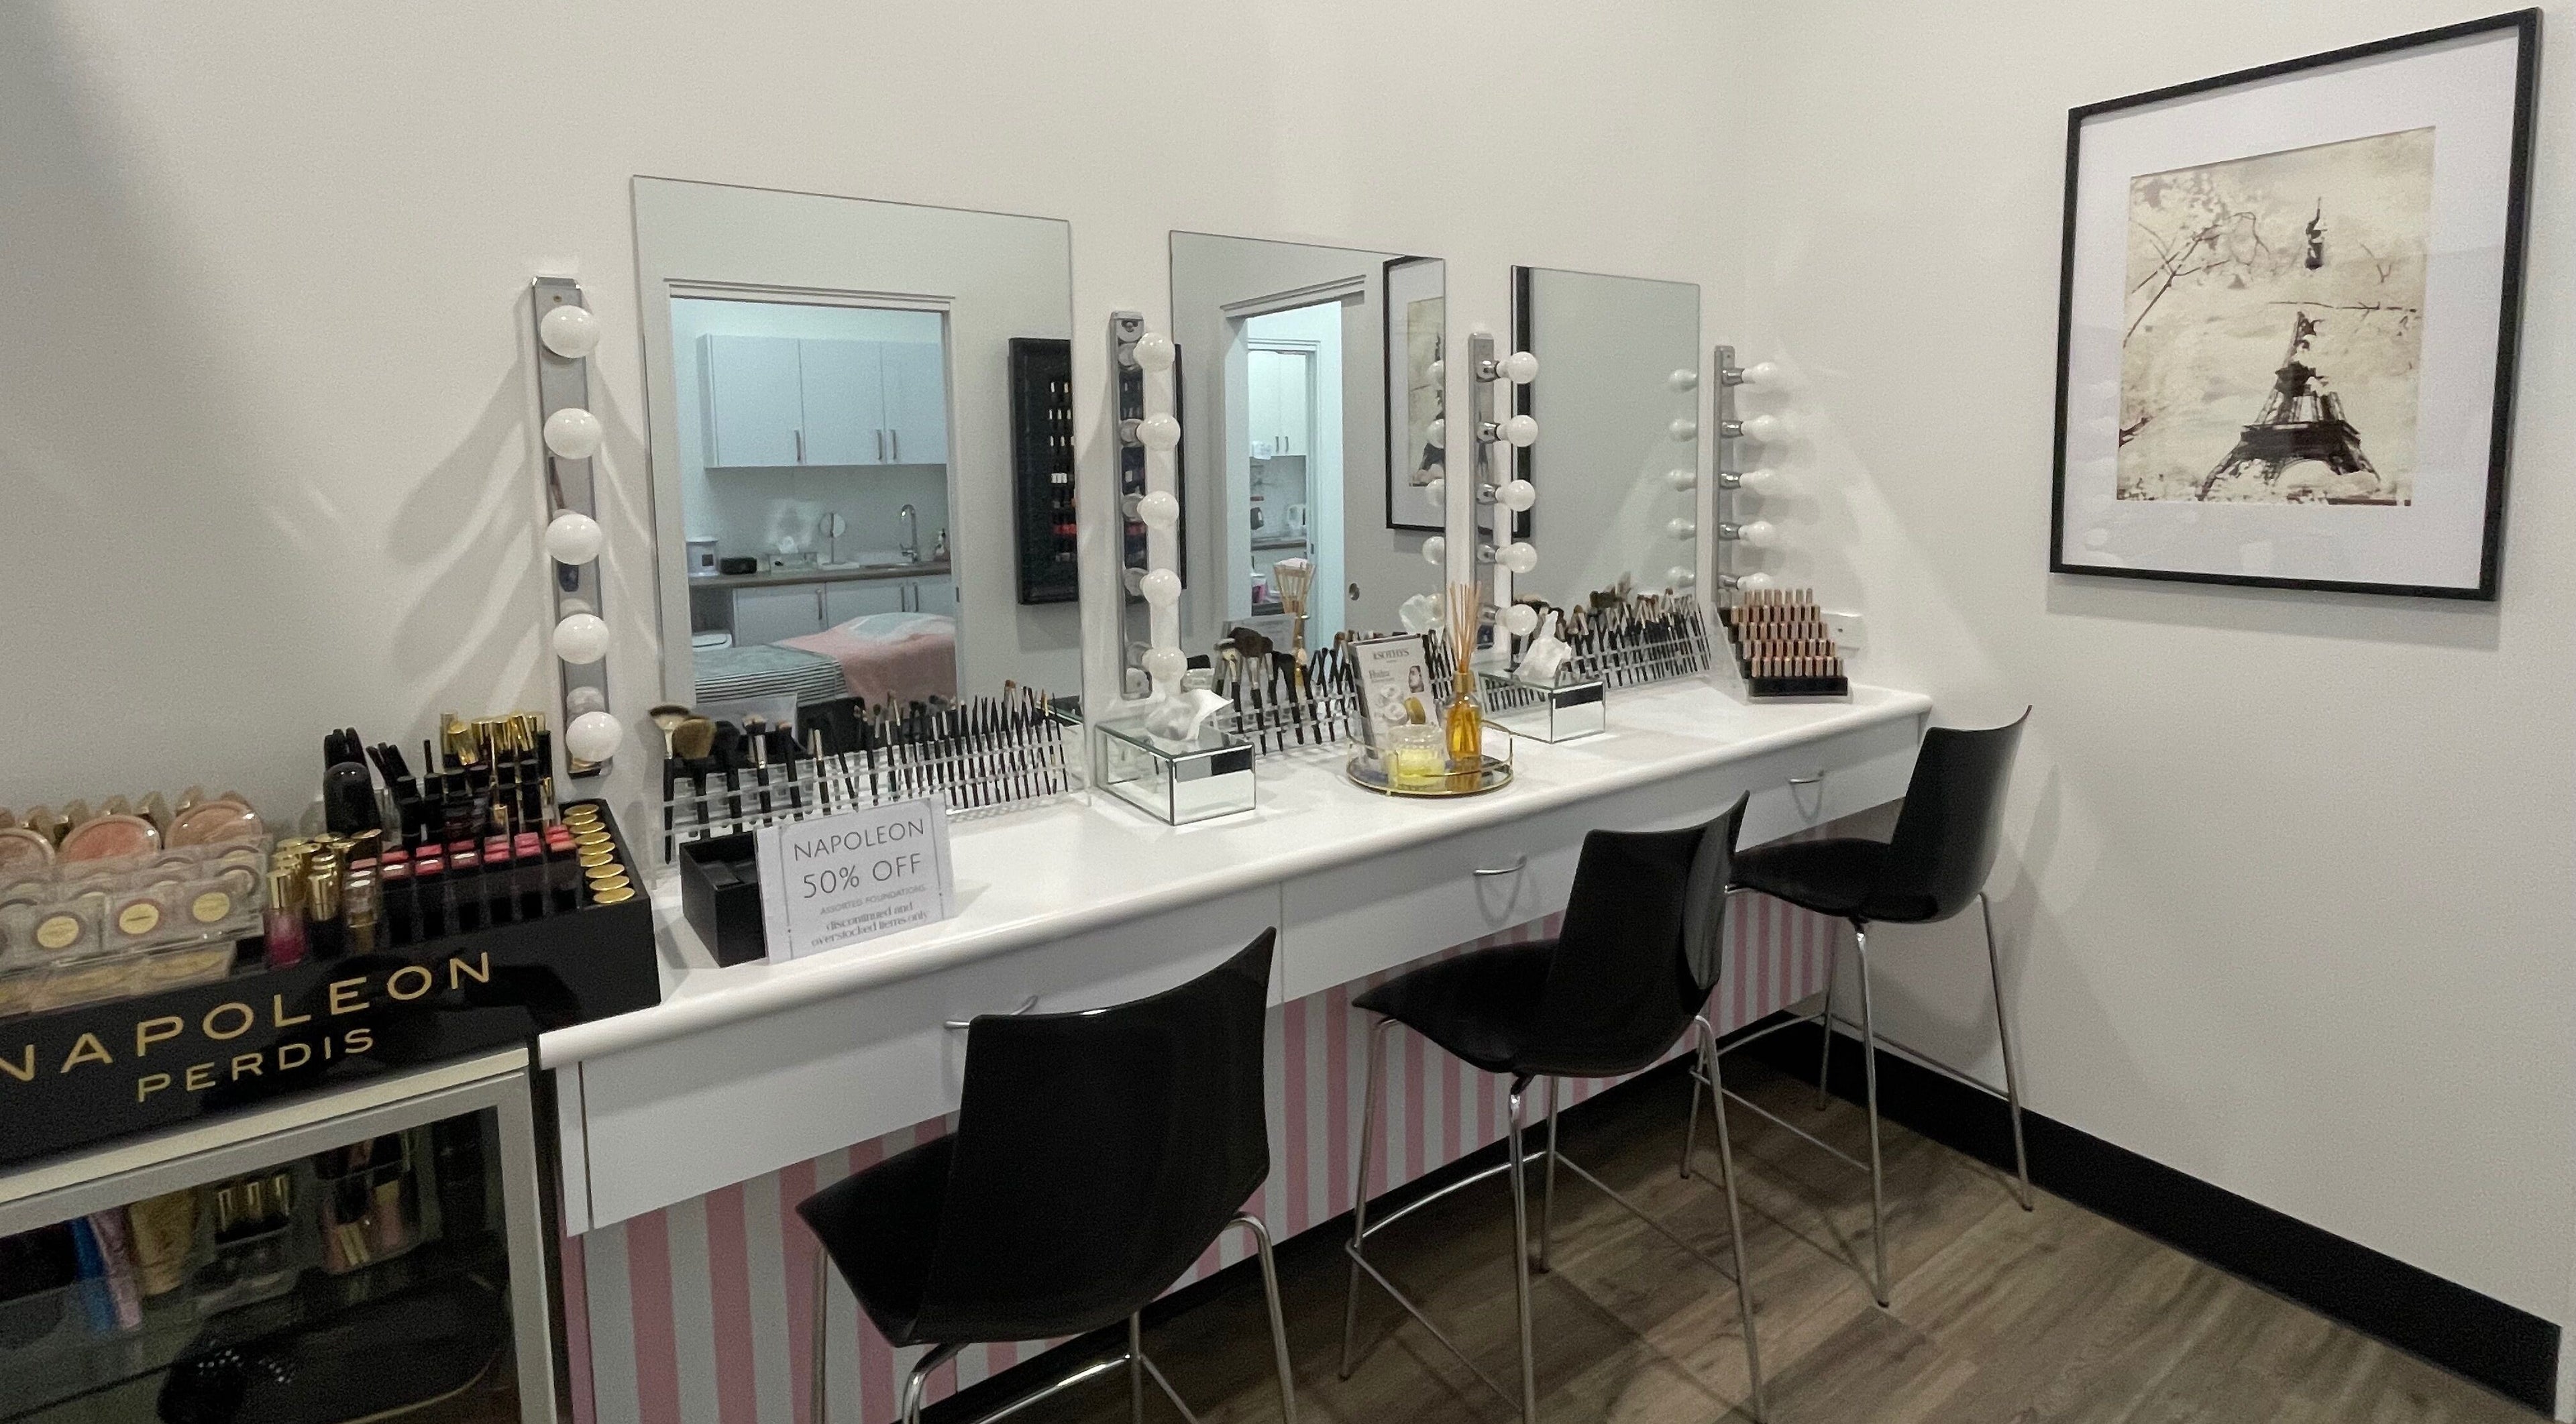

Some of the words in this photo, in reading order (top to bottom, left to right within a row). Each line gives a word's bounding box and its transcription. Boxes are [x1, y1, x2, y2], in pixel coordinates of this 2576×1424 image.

[794, 818, 924, 861] NAPOLEON
[803, 864, 860, 899] 50%
[872, 853, 922, 881] OFF
[820, 899, 863, 915] ASSORTED
[865, 884, 926, 903] FOUNDATIONS
[826, 906, 892, 930] discontinued
[894, 901, 914, 912] and
[810, 922, 877, 947] overstocked
[879, 918, 907, 930] items
[908, 910, 928, 923] only
[138, 1028, 375, 1103] PERDIS
